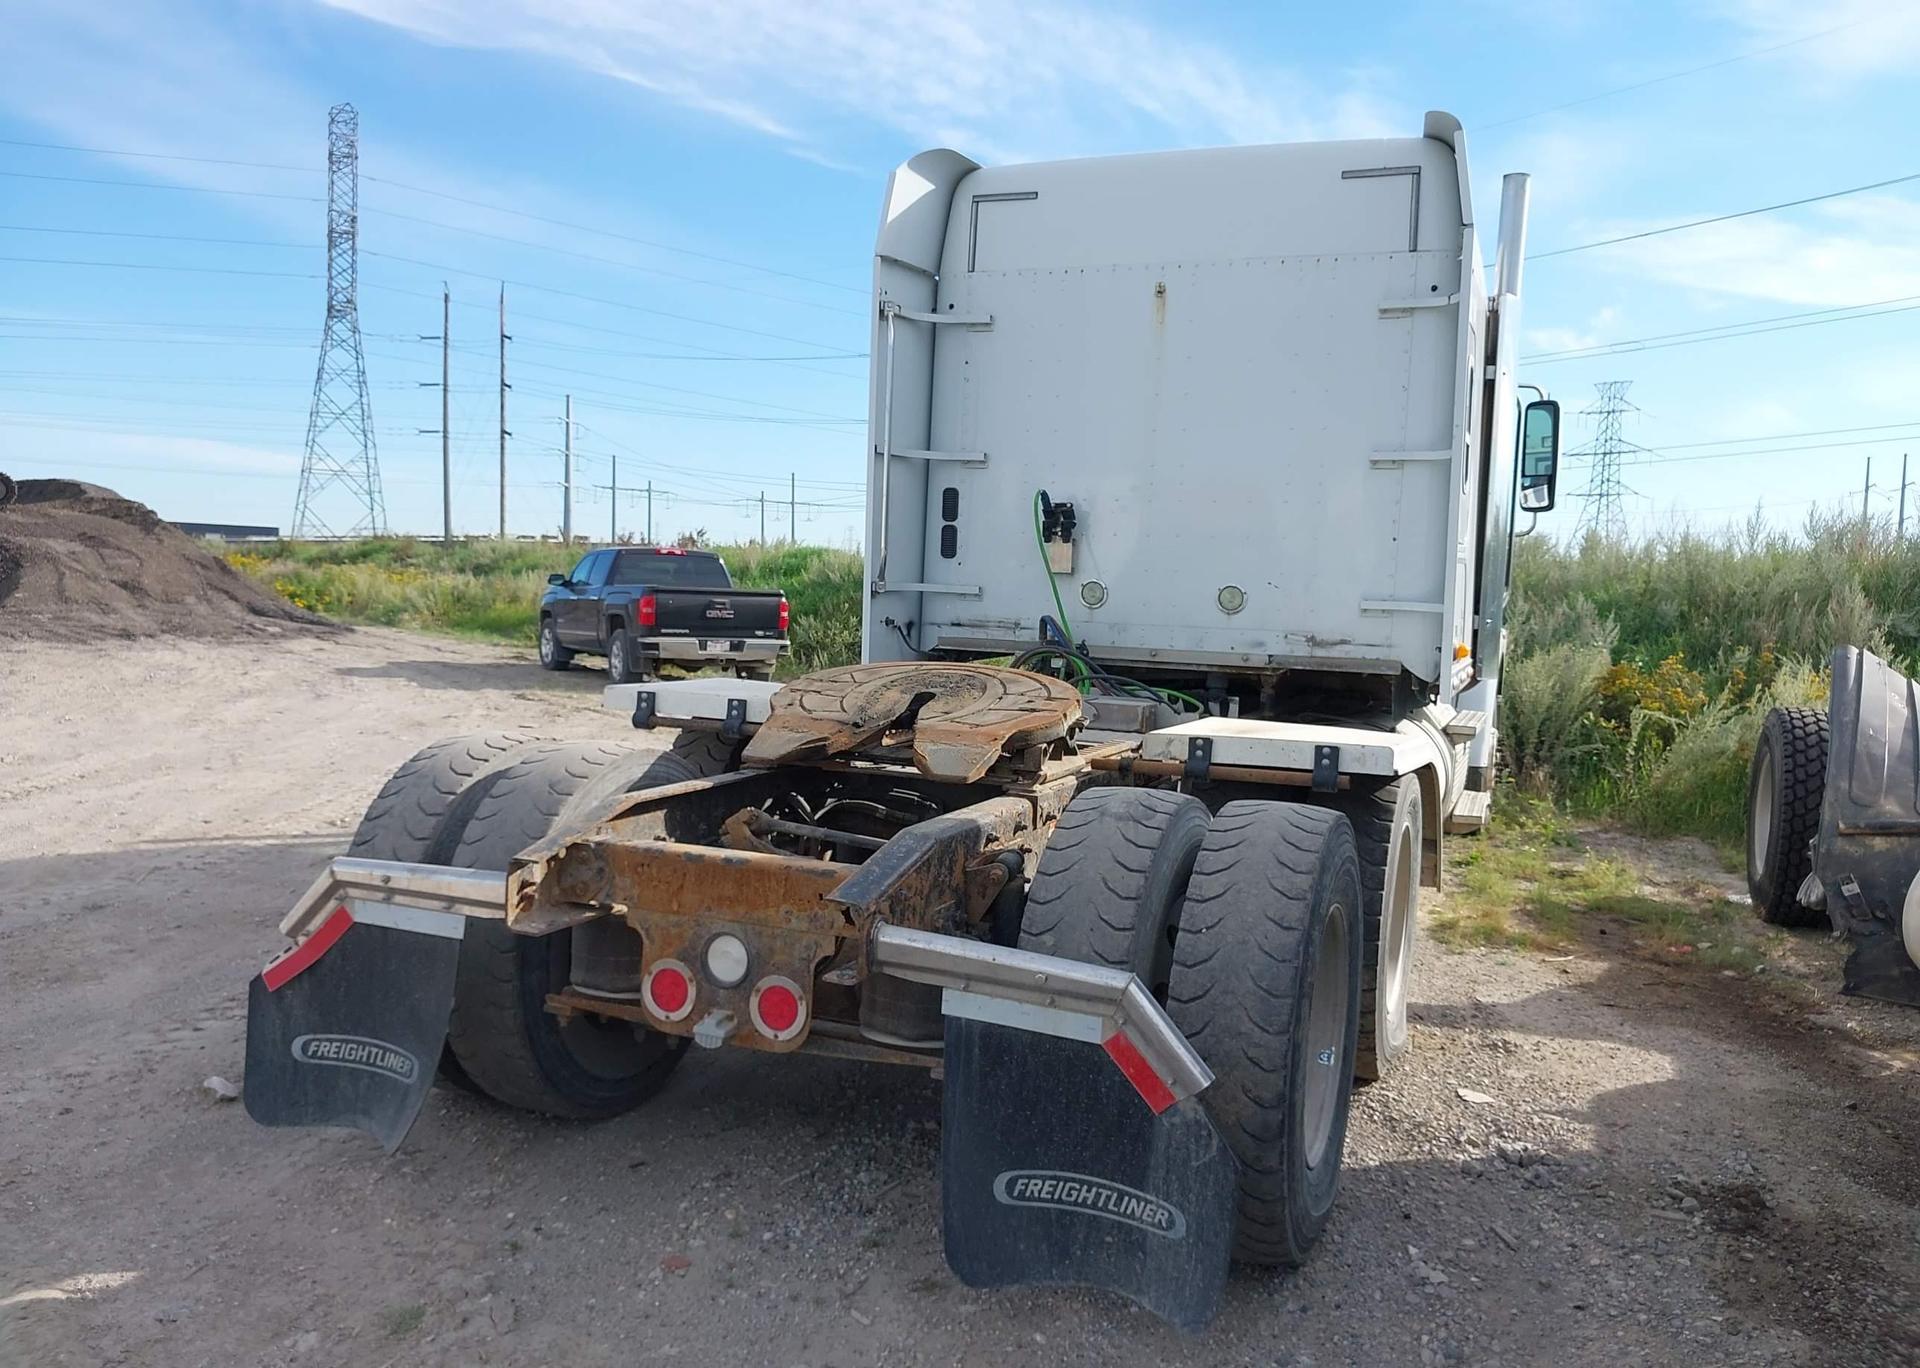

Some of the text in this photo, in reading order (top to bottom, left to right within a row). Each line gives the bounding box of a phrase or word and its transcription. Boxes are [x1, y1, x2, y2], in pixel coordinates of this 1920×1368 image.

[706, 610, 734, 618] GMC
[307, 1041, 411, 1076] FREIGHTLINER
[1012, 1179, 1169, 1228] FREIGHTLINER
